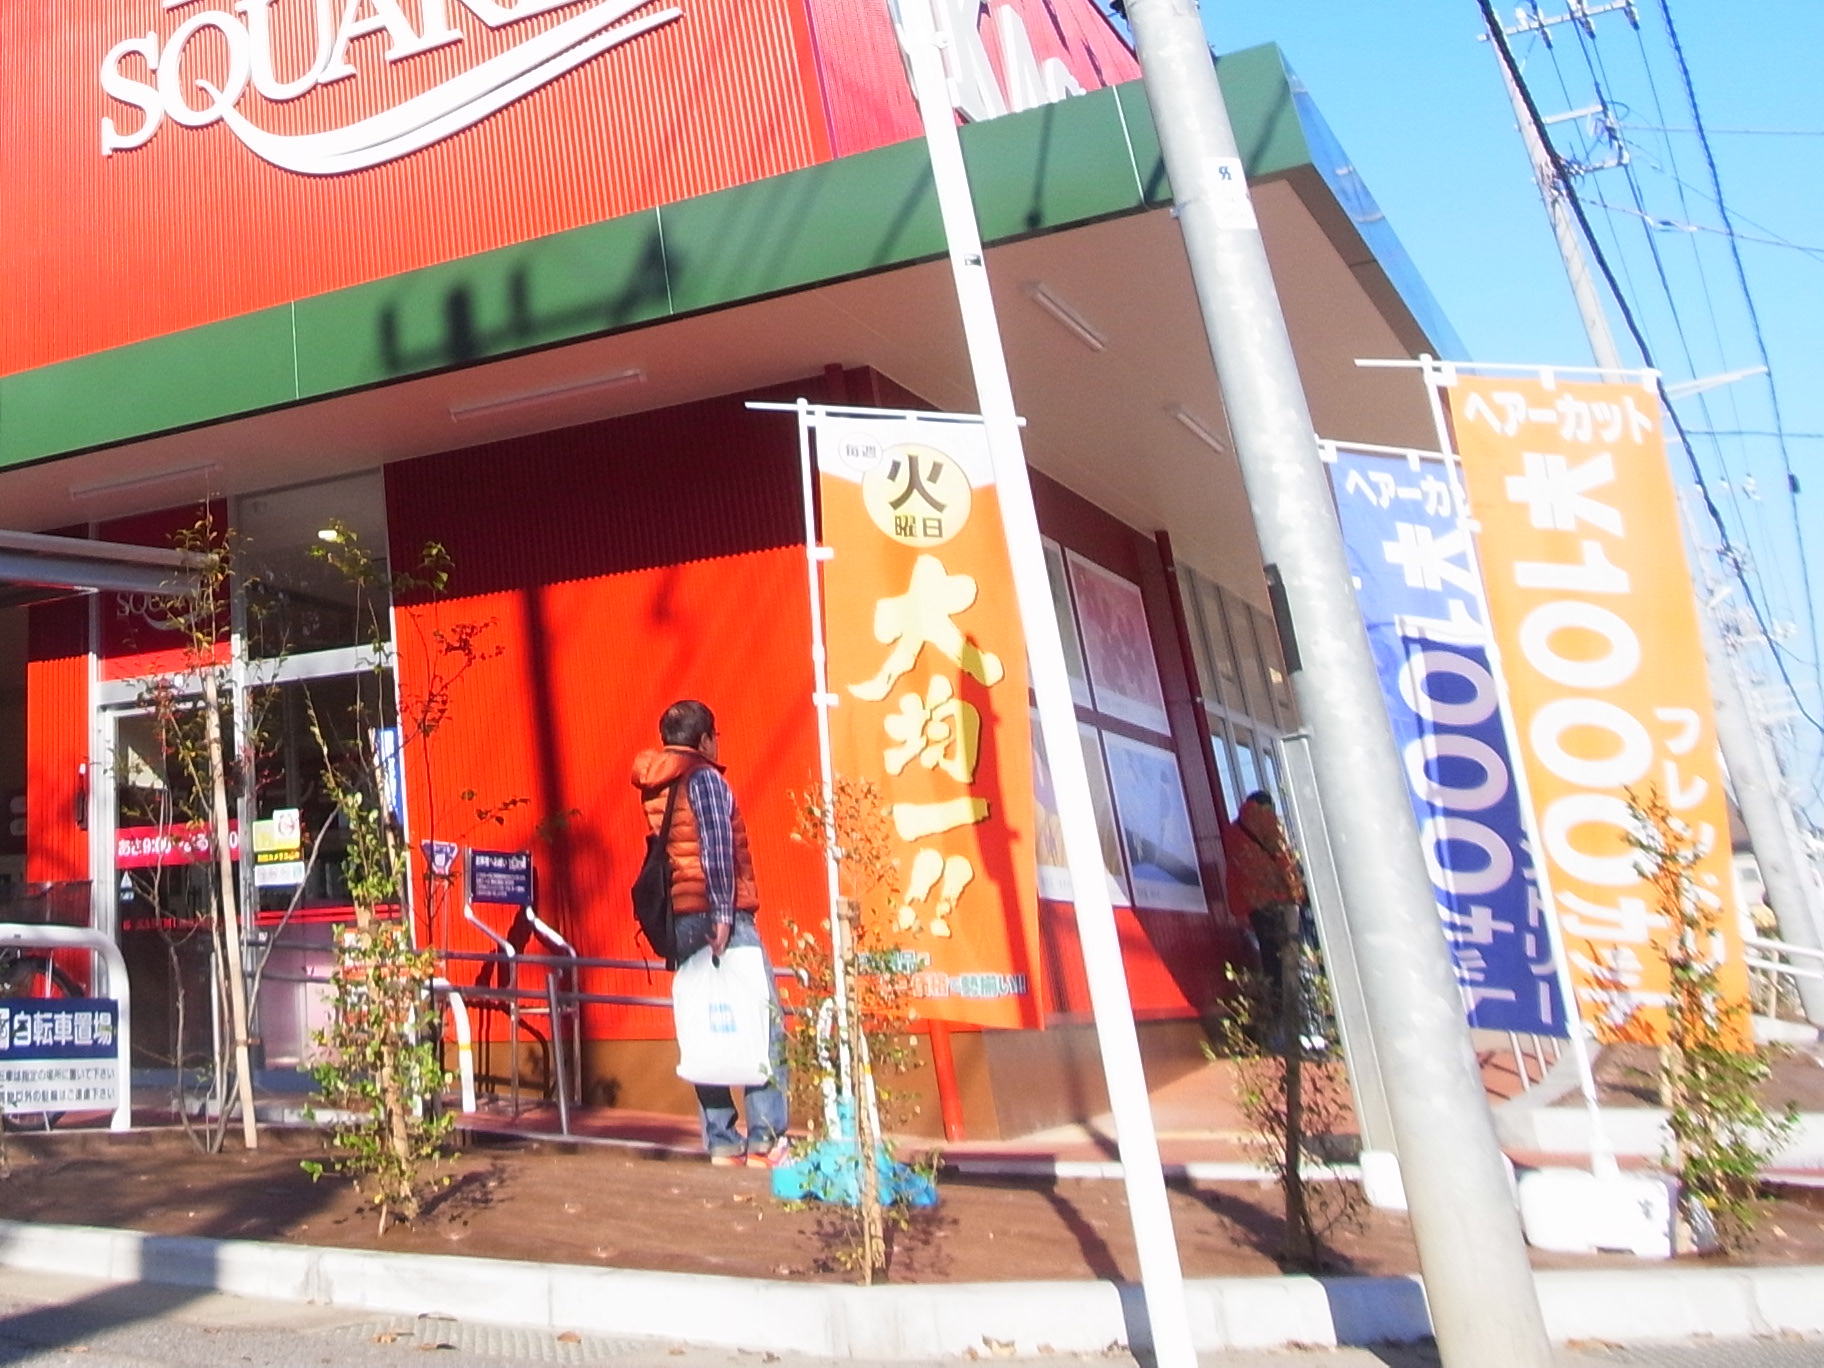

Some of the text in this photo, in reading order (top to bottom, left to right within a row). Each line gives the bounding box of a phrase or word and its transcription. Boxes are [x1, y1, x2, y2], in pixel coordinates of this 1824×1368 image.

[1464, 390, 1654, 444] ヘアーカット
[886, 454, 948, 514] 火
[1346, 468, 1464, 519] ヘアーカ
[893, 514, 944, 539] 曜日
[13, 1010, 113, 1047] 自転車置場
